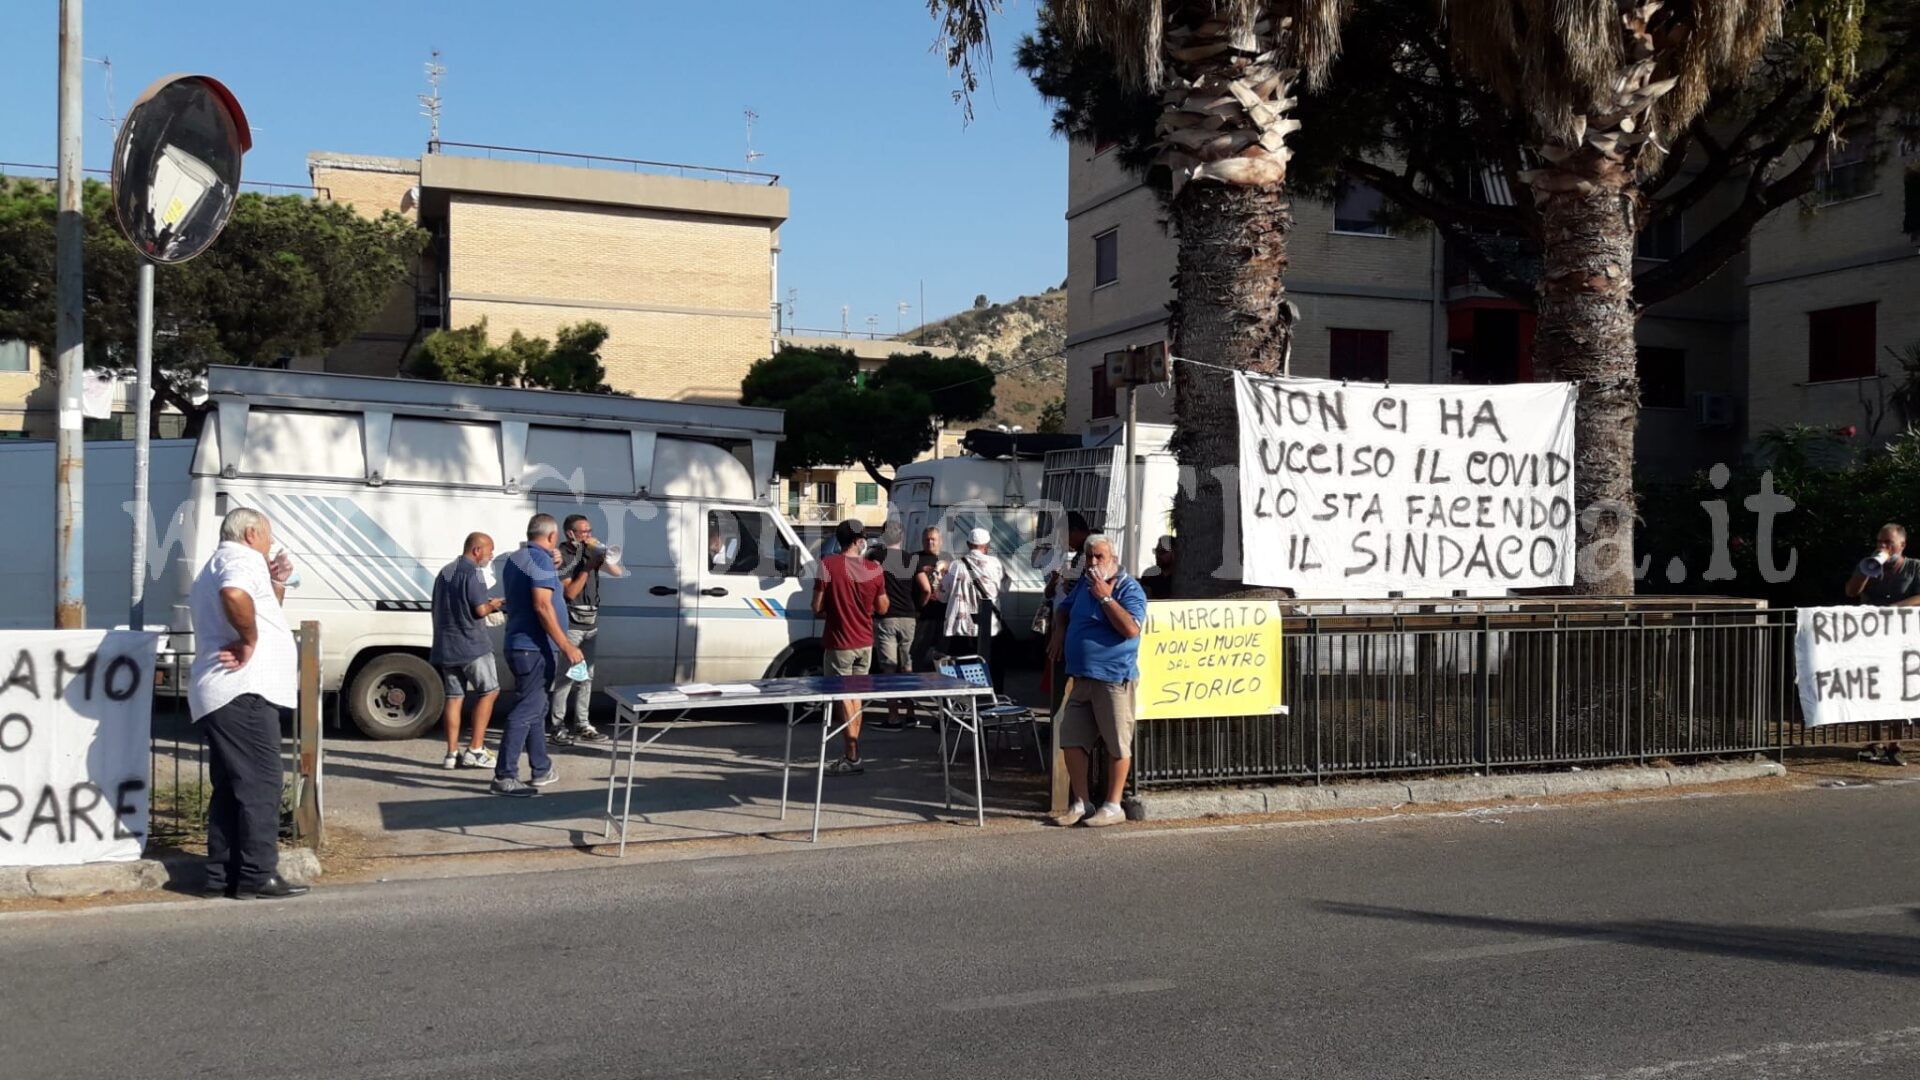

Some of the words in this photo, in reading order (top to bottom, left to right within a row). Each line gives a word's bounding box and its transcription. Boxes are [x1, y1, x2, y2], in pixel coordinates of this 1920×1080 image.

[1254, 385, 1347, 431] NON
[1372, 397, 1407, 433] CI
[1439, 398, 1508, 443] HA
[1258, 437, 1395, 478] UCCISO
[1414, 447, 1450, 484] IL
[1466, 450, 1570, 488] COVID
[1254, 487, 1298, 518] LO
[1312, 492, 1383, 524] STA
[1406, 495, 1572, 530] FACENDO
[1288, 533, 1322, 571] IL
[1344, 531, 1558, 579] SINDACO
[1144, 614, 1160, 635] IL
[1170, 607, 1267, 632] MERCATO
[1813, 608, 1920, 645] RIDOTT
[1155, 640, 1189, 656] NON
[1192, 637, 1209, 652] SI
[1213, 633, 1263, 650] MUOVE
[1198, 652, 1265, 667] CENTRO
[1152, 677, 1261, 706] STORICO
[1815, 666, 1880, 702] FAME
